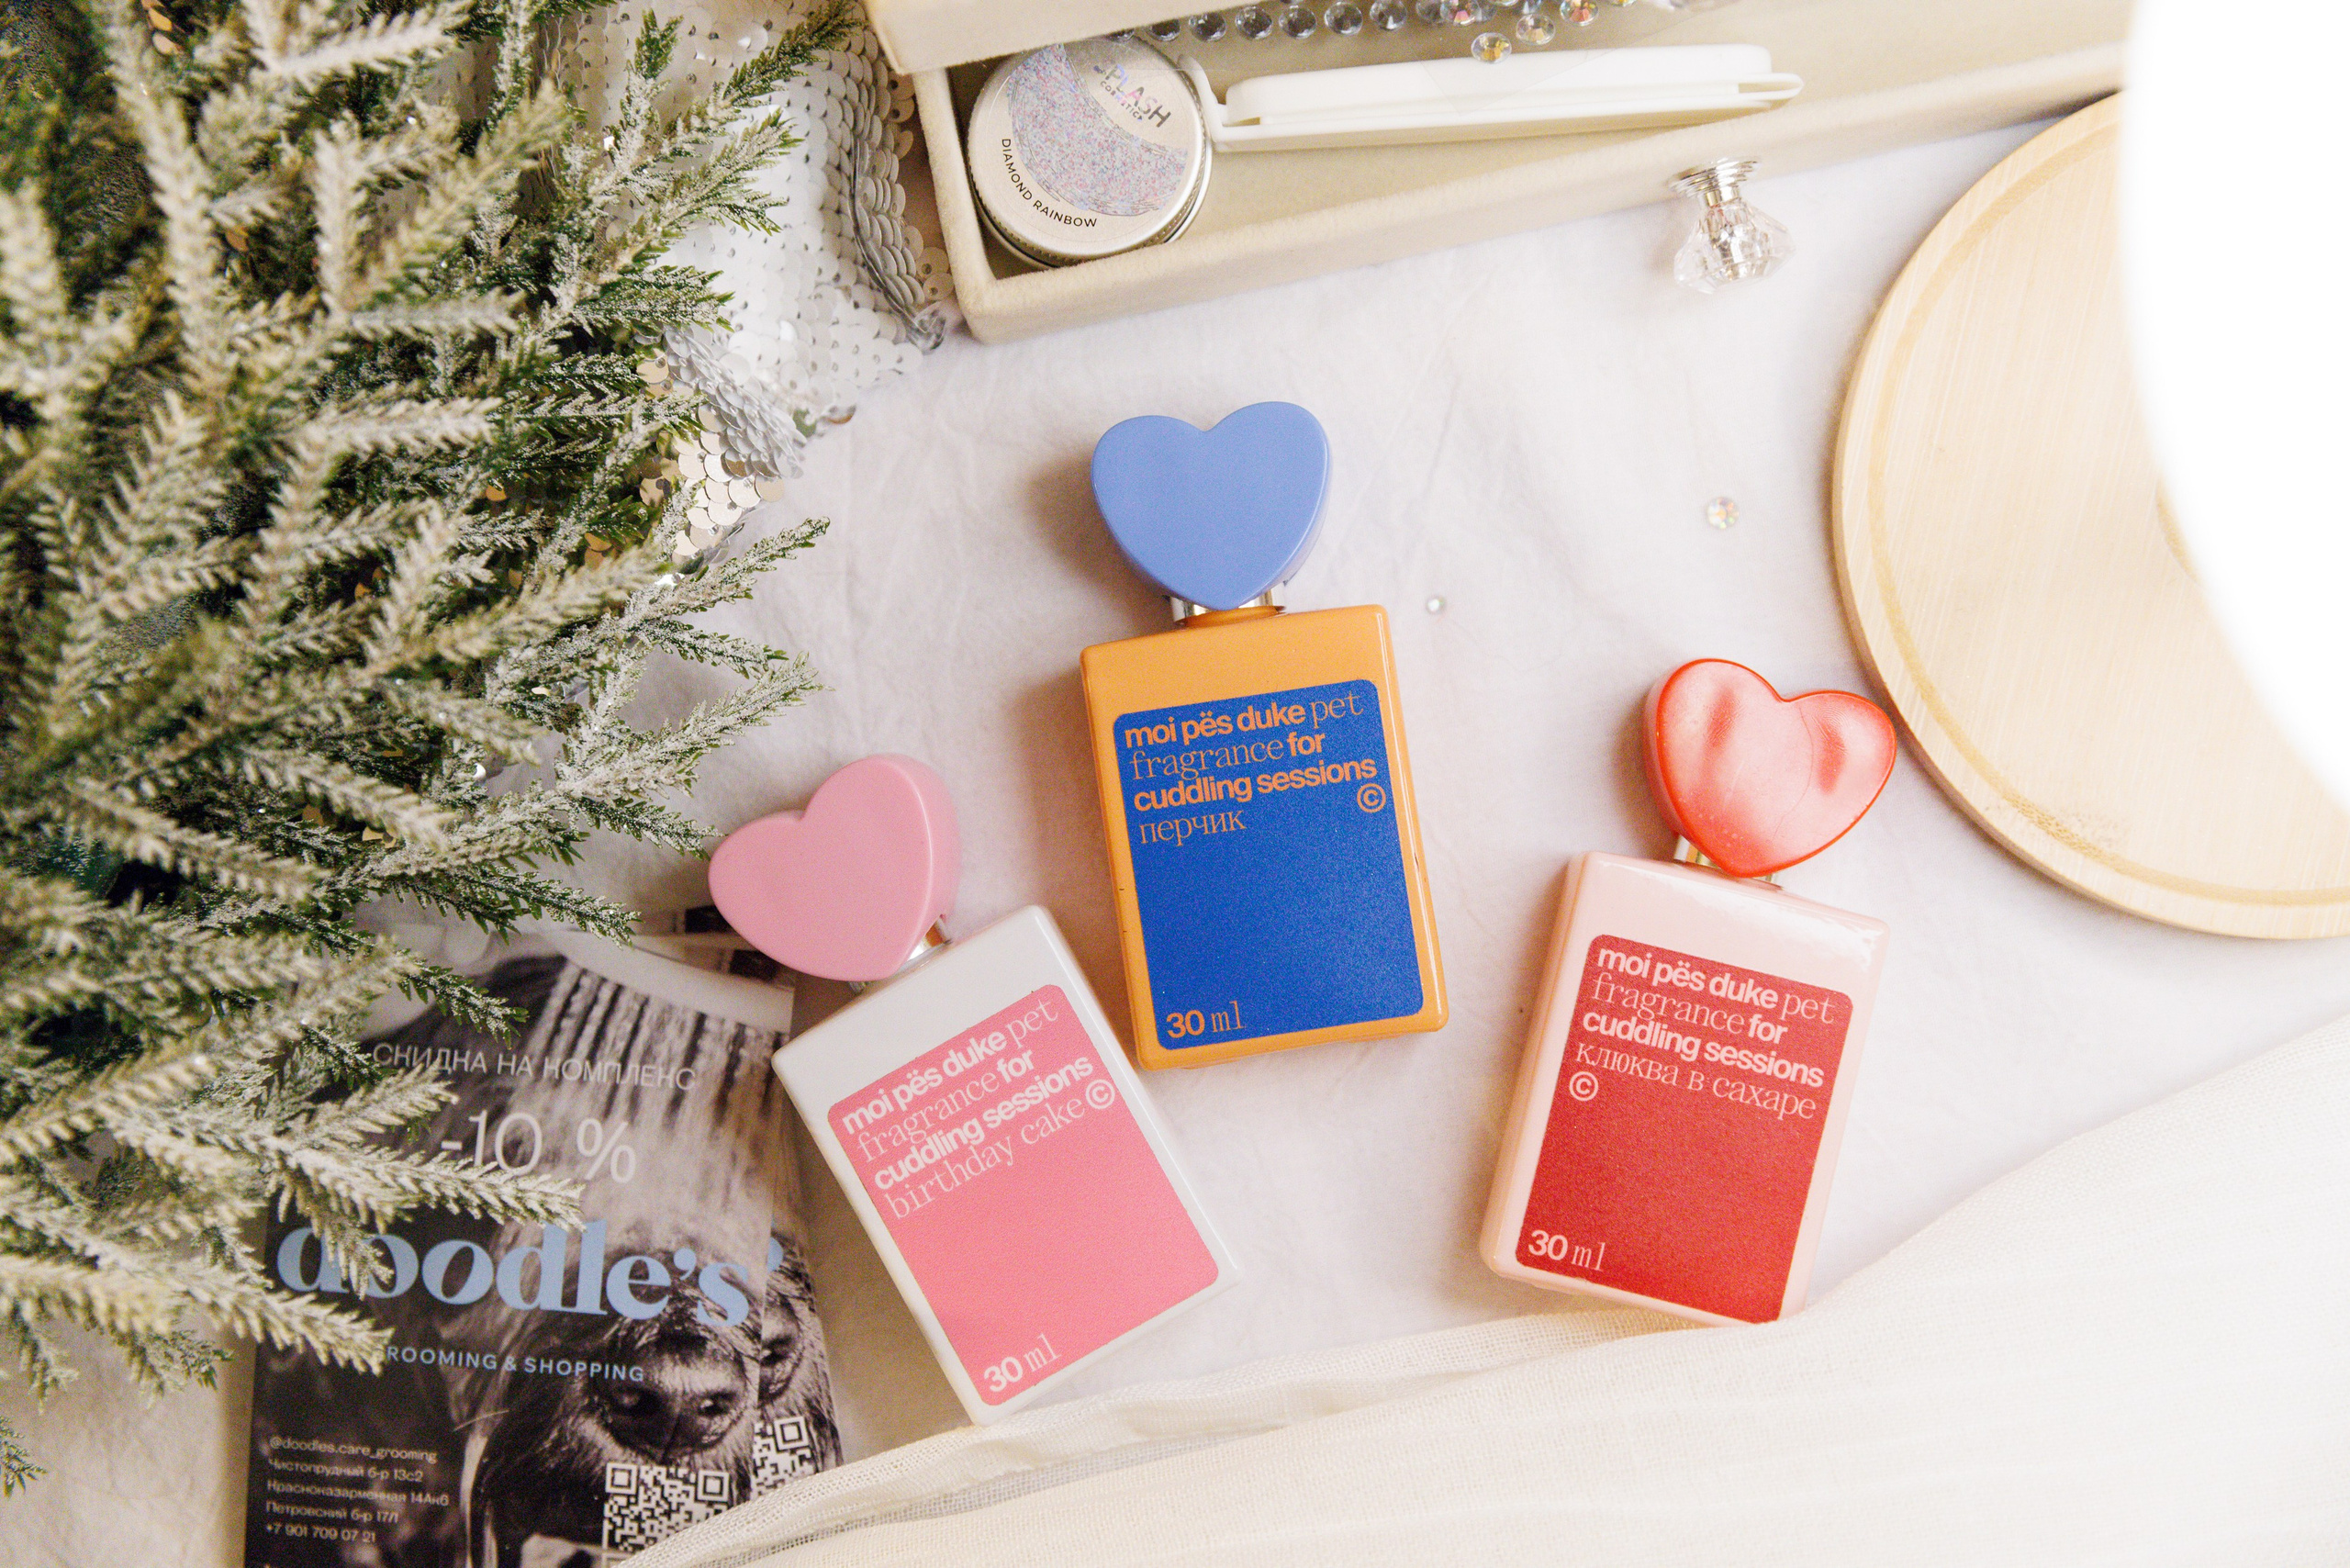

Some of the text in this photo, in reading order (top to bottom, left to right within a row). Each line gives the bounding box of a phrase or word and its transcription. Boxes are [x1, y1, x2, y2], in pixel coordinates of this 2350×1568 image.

[1002, 139, 1097, 227] DIAMOND RAINBOW
[1125, 690, 1364, 748] moi pës duke pet
[1129, 732, 1326, 780] fragrance for
[1134, 758, 1377, 812] cuddling sessions
[1139, 810, 1247, 846] перчик
[1167, 1000, 1246, 1038] 30 ml
[1593, 972, 1788, 1045] fragrance for
[1597, 947, 1836, 1025] moi pës duke pet
[497, 1053, 533, 1078] НА
[842, 999, 1058, 1134] moi pës duke pet
[1576, 1043, 1817, 1121] клюква в сахаре
[1583, 1012, 1824, 1088] cuddling sessions
[857, 1049, 1035, 1162] fragrance for
[875, 1057, 1093, 1190] cuddling sessions
[441, 1109, 636, 1184] -10 %
[885, 1136, 1013, 1219] birthday
[1021, 1098, 1086, 1145] cake
[1528, 1229, 1606, 1271] 30 ml
[386, 1346, 643, 1382] ROOMING & SHOPPING
[984, 1333, 1062, 1392] 30 ml
[269, 1435, 438, 1464] @doodles.care_grooming
